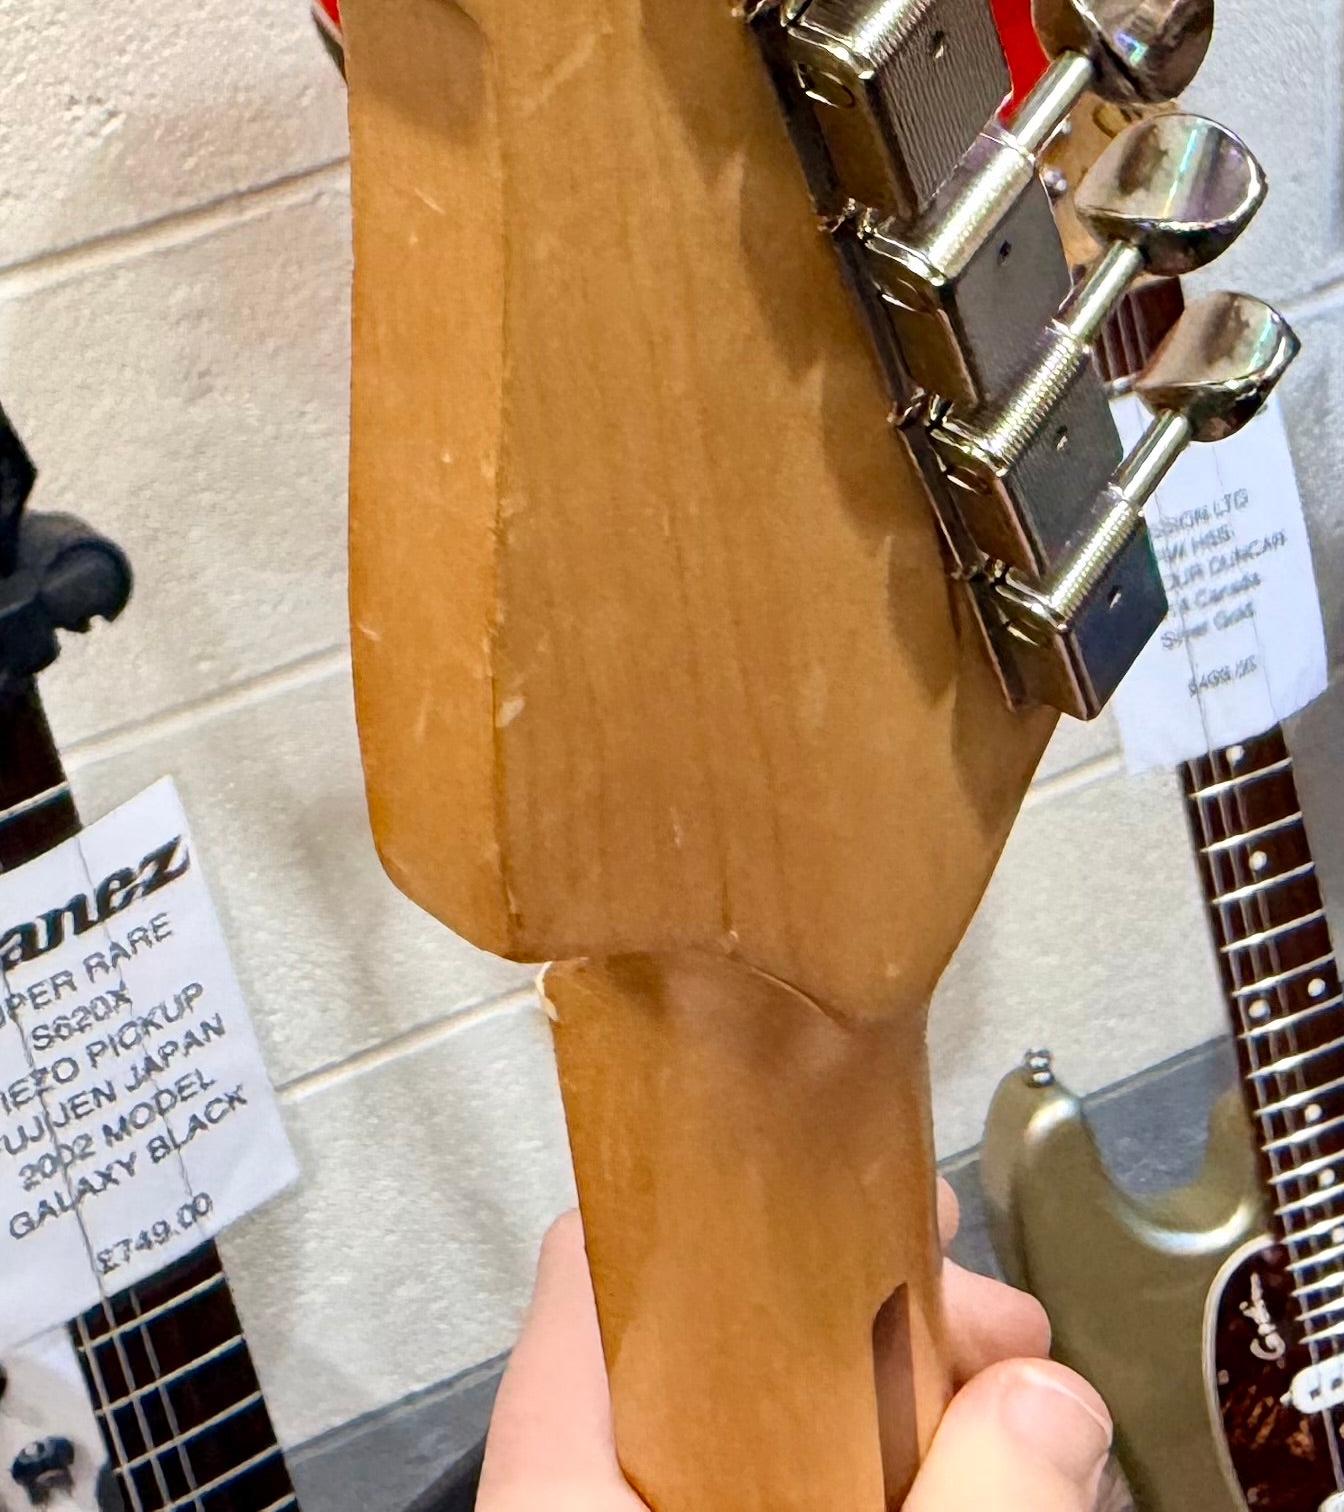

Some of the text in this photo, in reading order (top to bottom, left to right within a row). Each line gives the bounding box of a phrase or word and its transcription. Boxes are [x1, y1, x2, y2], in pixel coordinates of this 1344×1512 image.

[82, 912, 174, 985] RARE
[88, 981, 205, 1070] PICKUP
[126, 1012, 226, 1089] JAPAN
[8, 1084, 249, 1241] GALAXY BLACK
[17, 1067, 216, 1192] 2002 MODEL
[95, 1191, 213, 1276] £749.00
